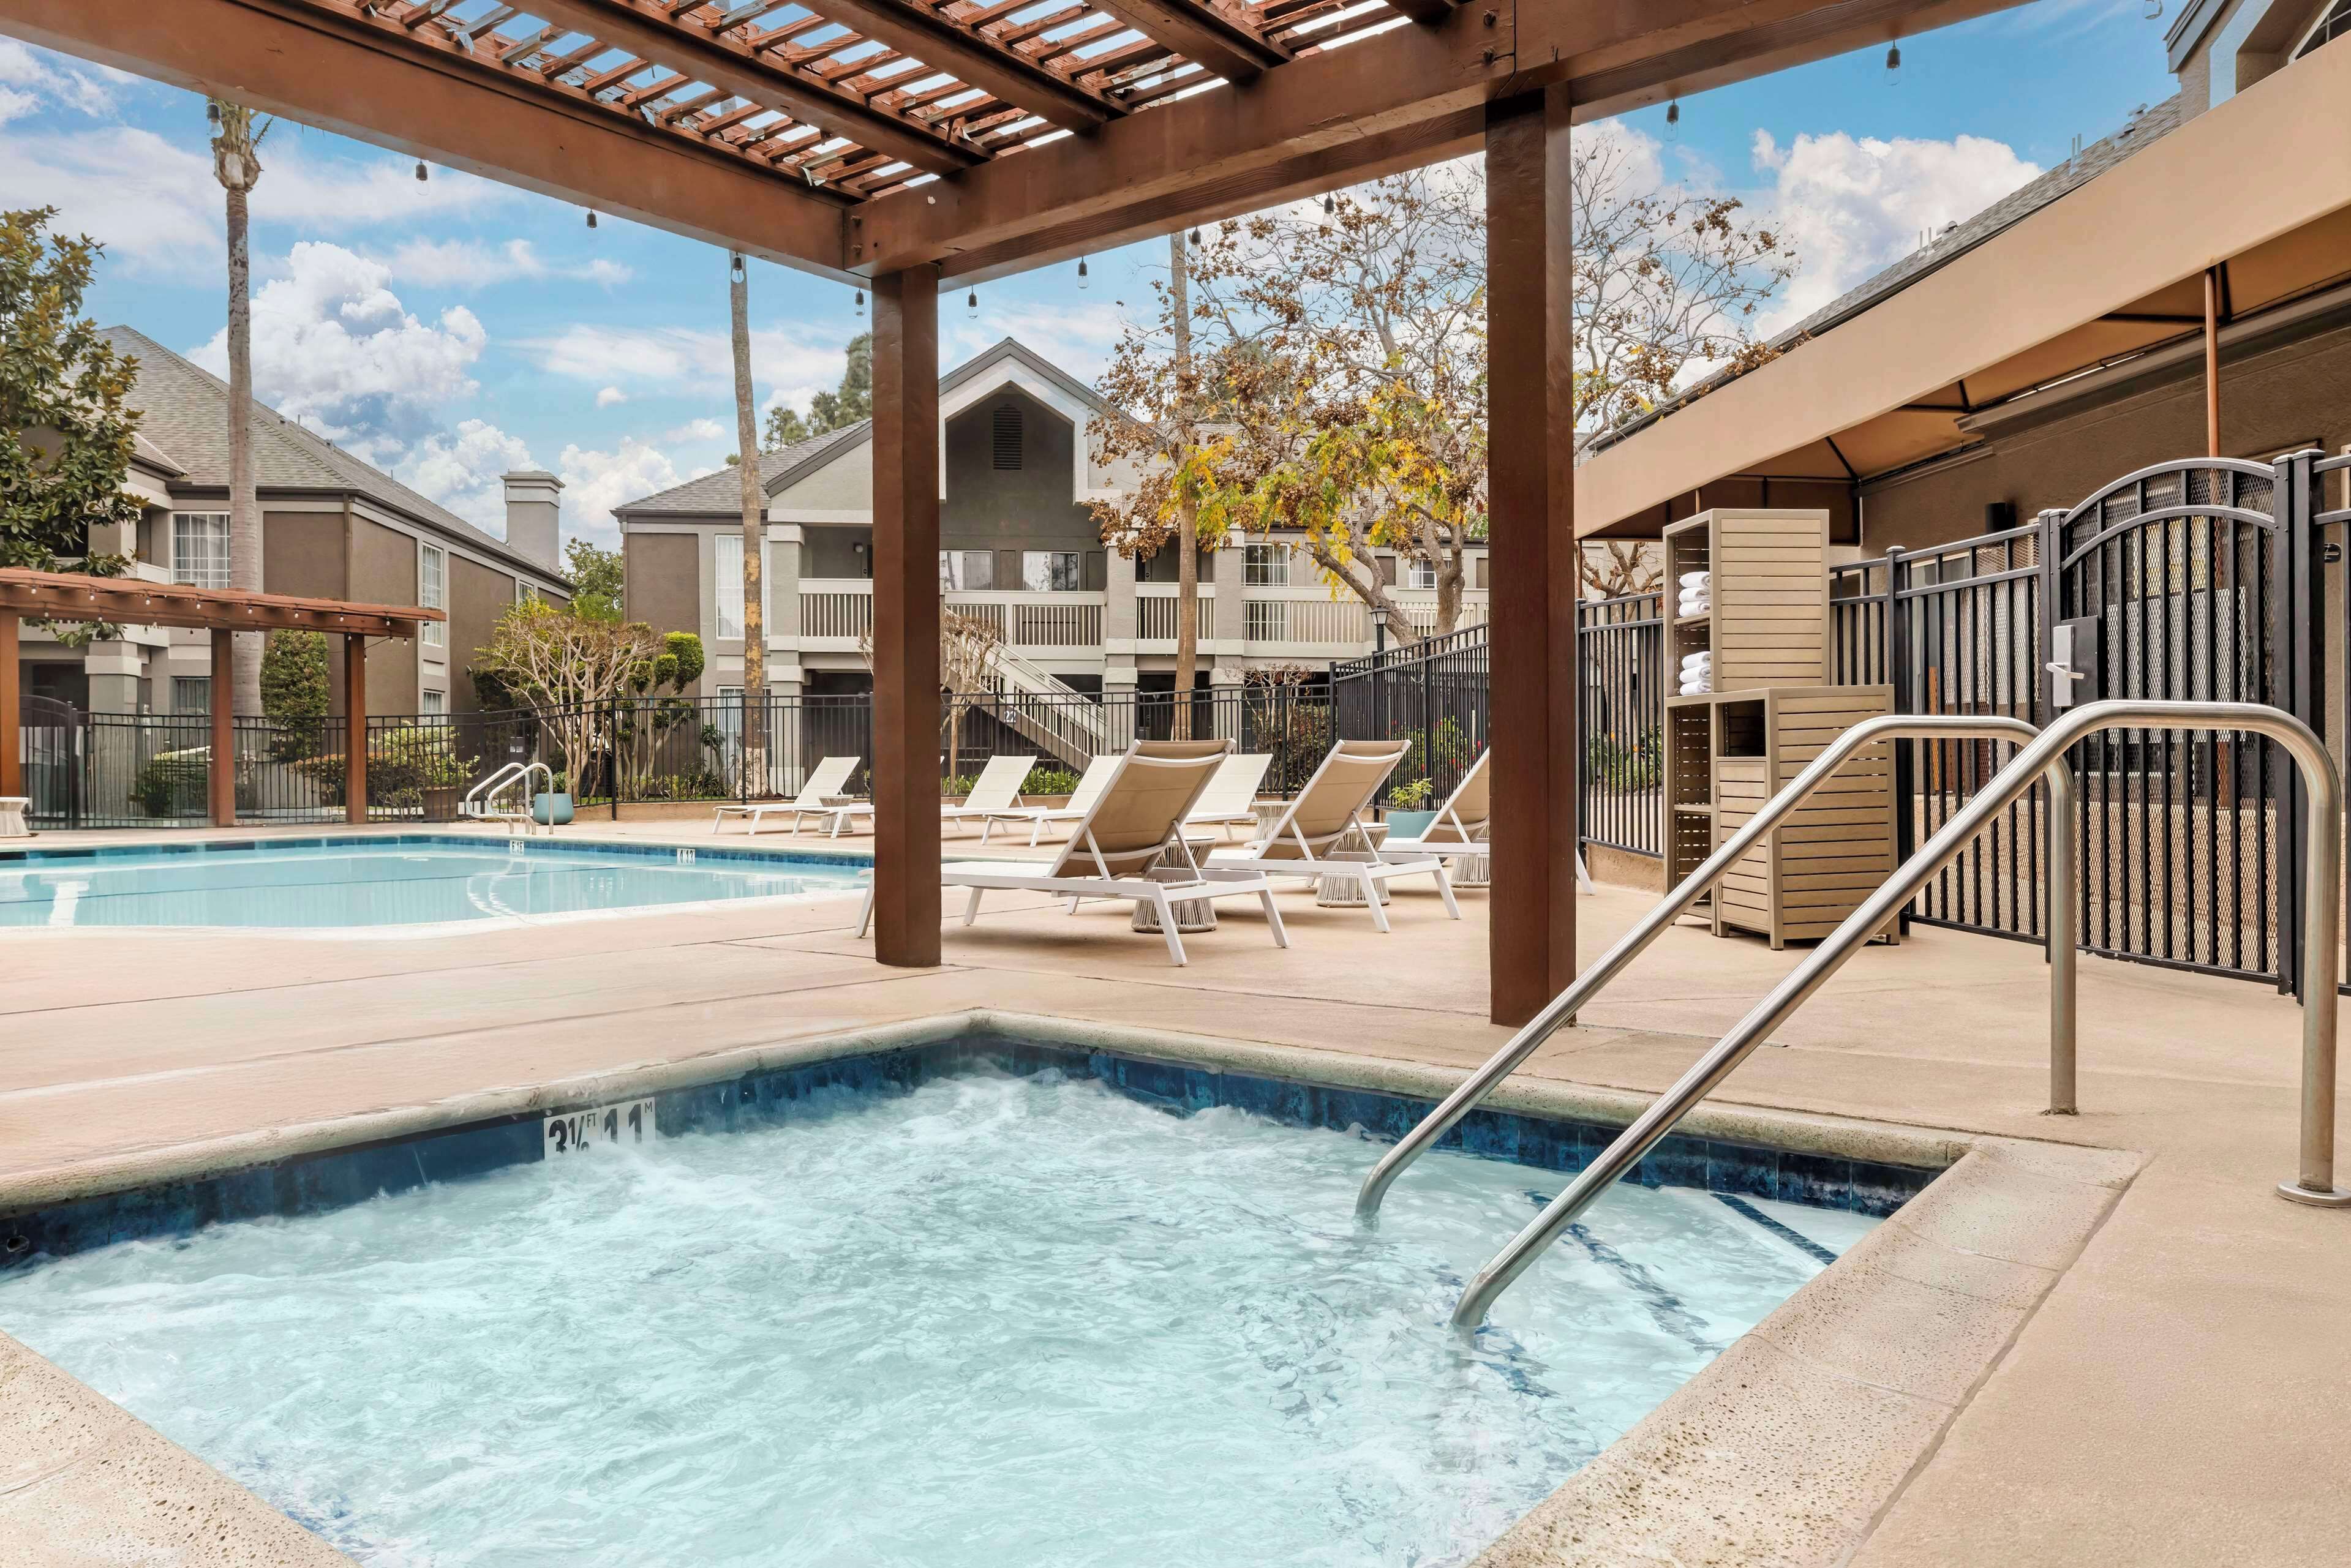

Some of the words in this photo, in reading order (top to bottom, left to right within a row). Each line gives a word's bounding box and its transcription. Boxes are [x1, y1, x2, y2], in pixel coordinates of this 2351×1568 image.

[1004, 710, 1016, 722] 22
[587, 1113, 597, 1128] FT
[645, 1101, 653, 1114] M
